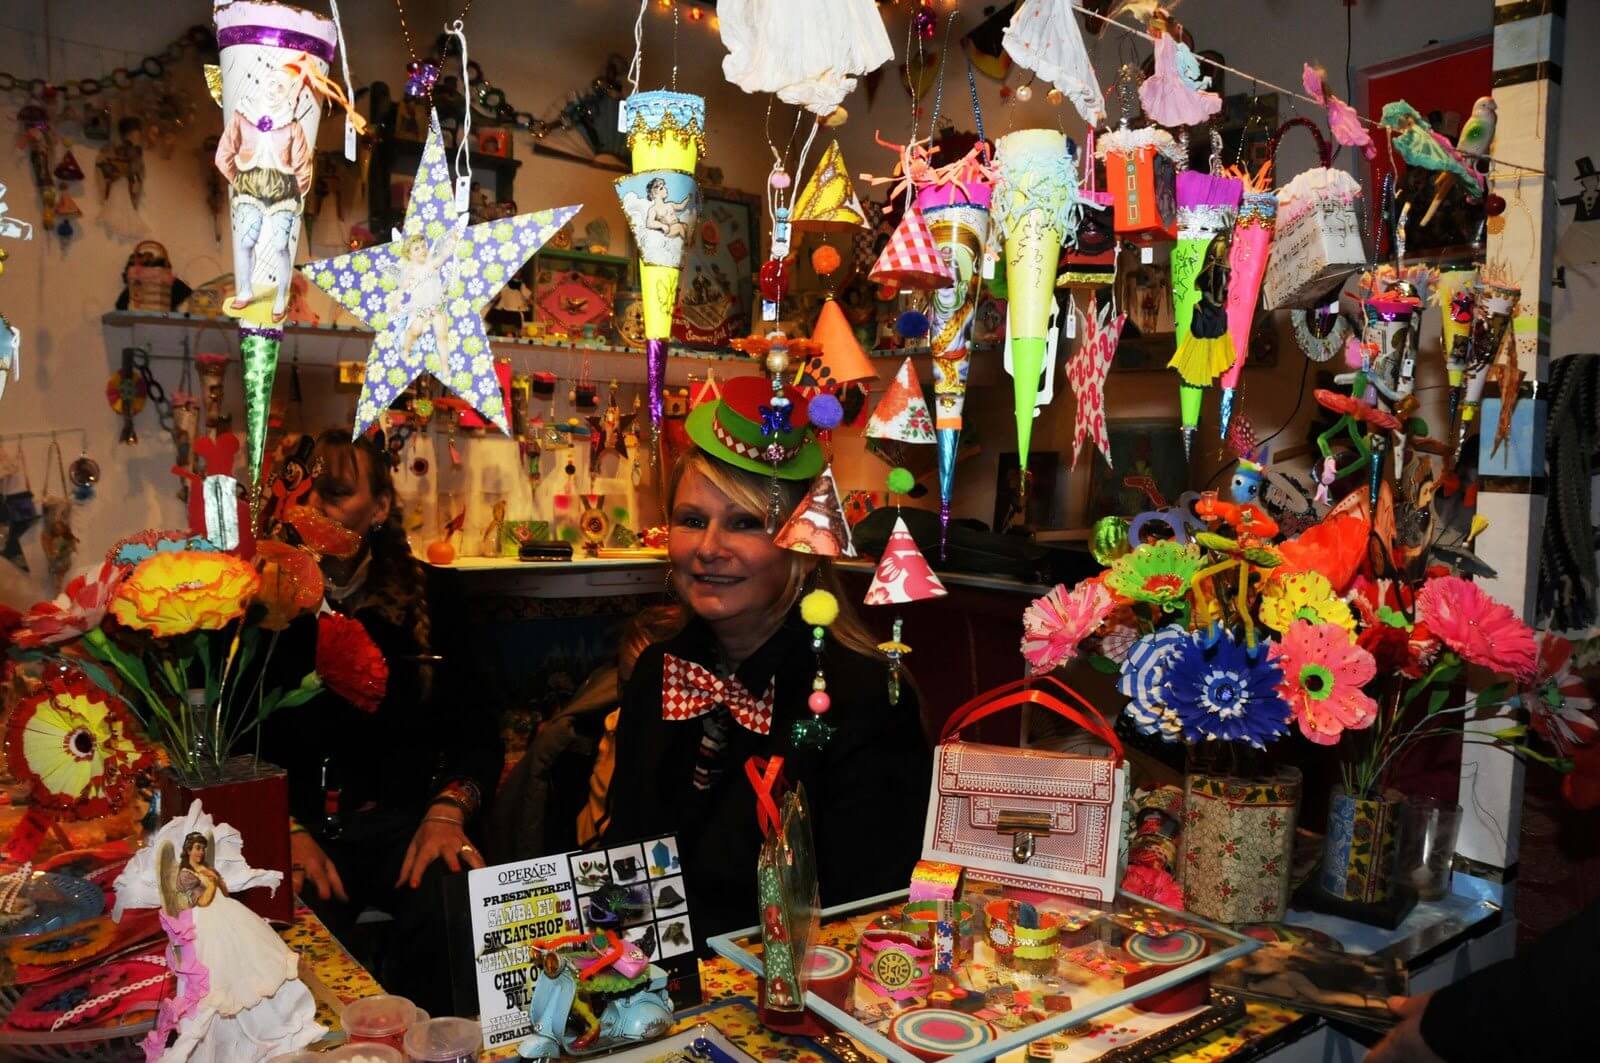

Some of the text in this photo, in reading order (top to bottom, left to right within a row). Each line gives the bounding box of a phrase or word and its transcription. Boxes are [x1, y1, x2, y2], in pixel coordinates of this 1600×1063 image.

[484, 917, 563, 949] SWEATSHOP
[494, 967, 528, 991] CHIN
[505, 987, 536, 1009] DUL
